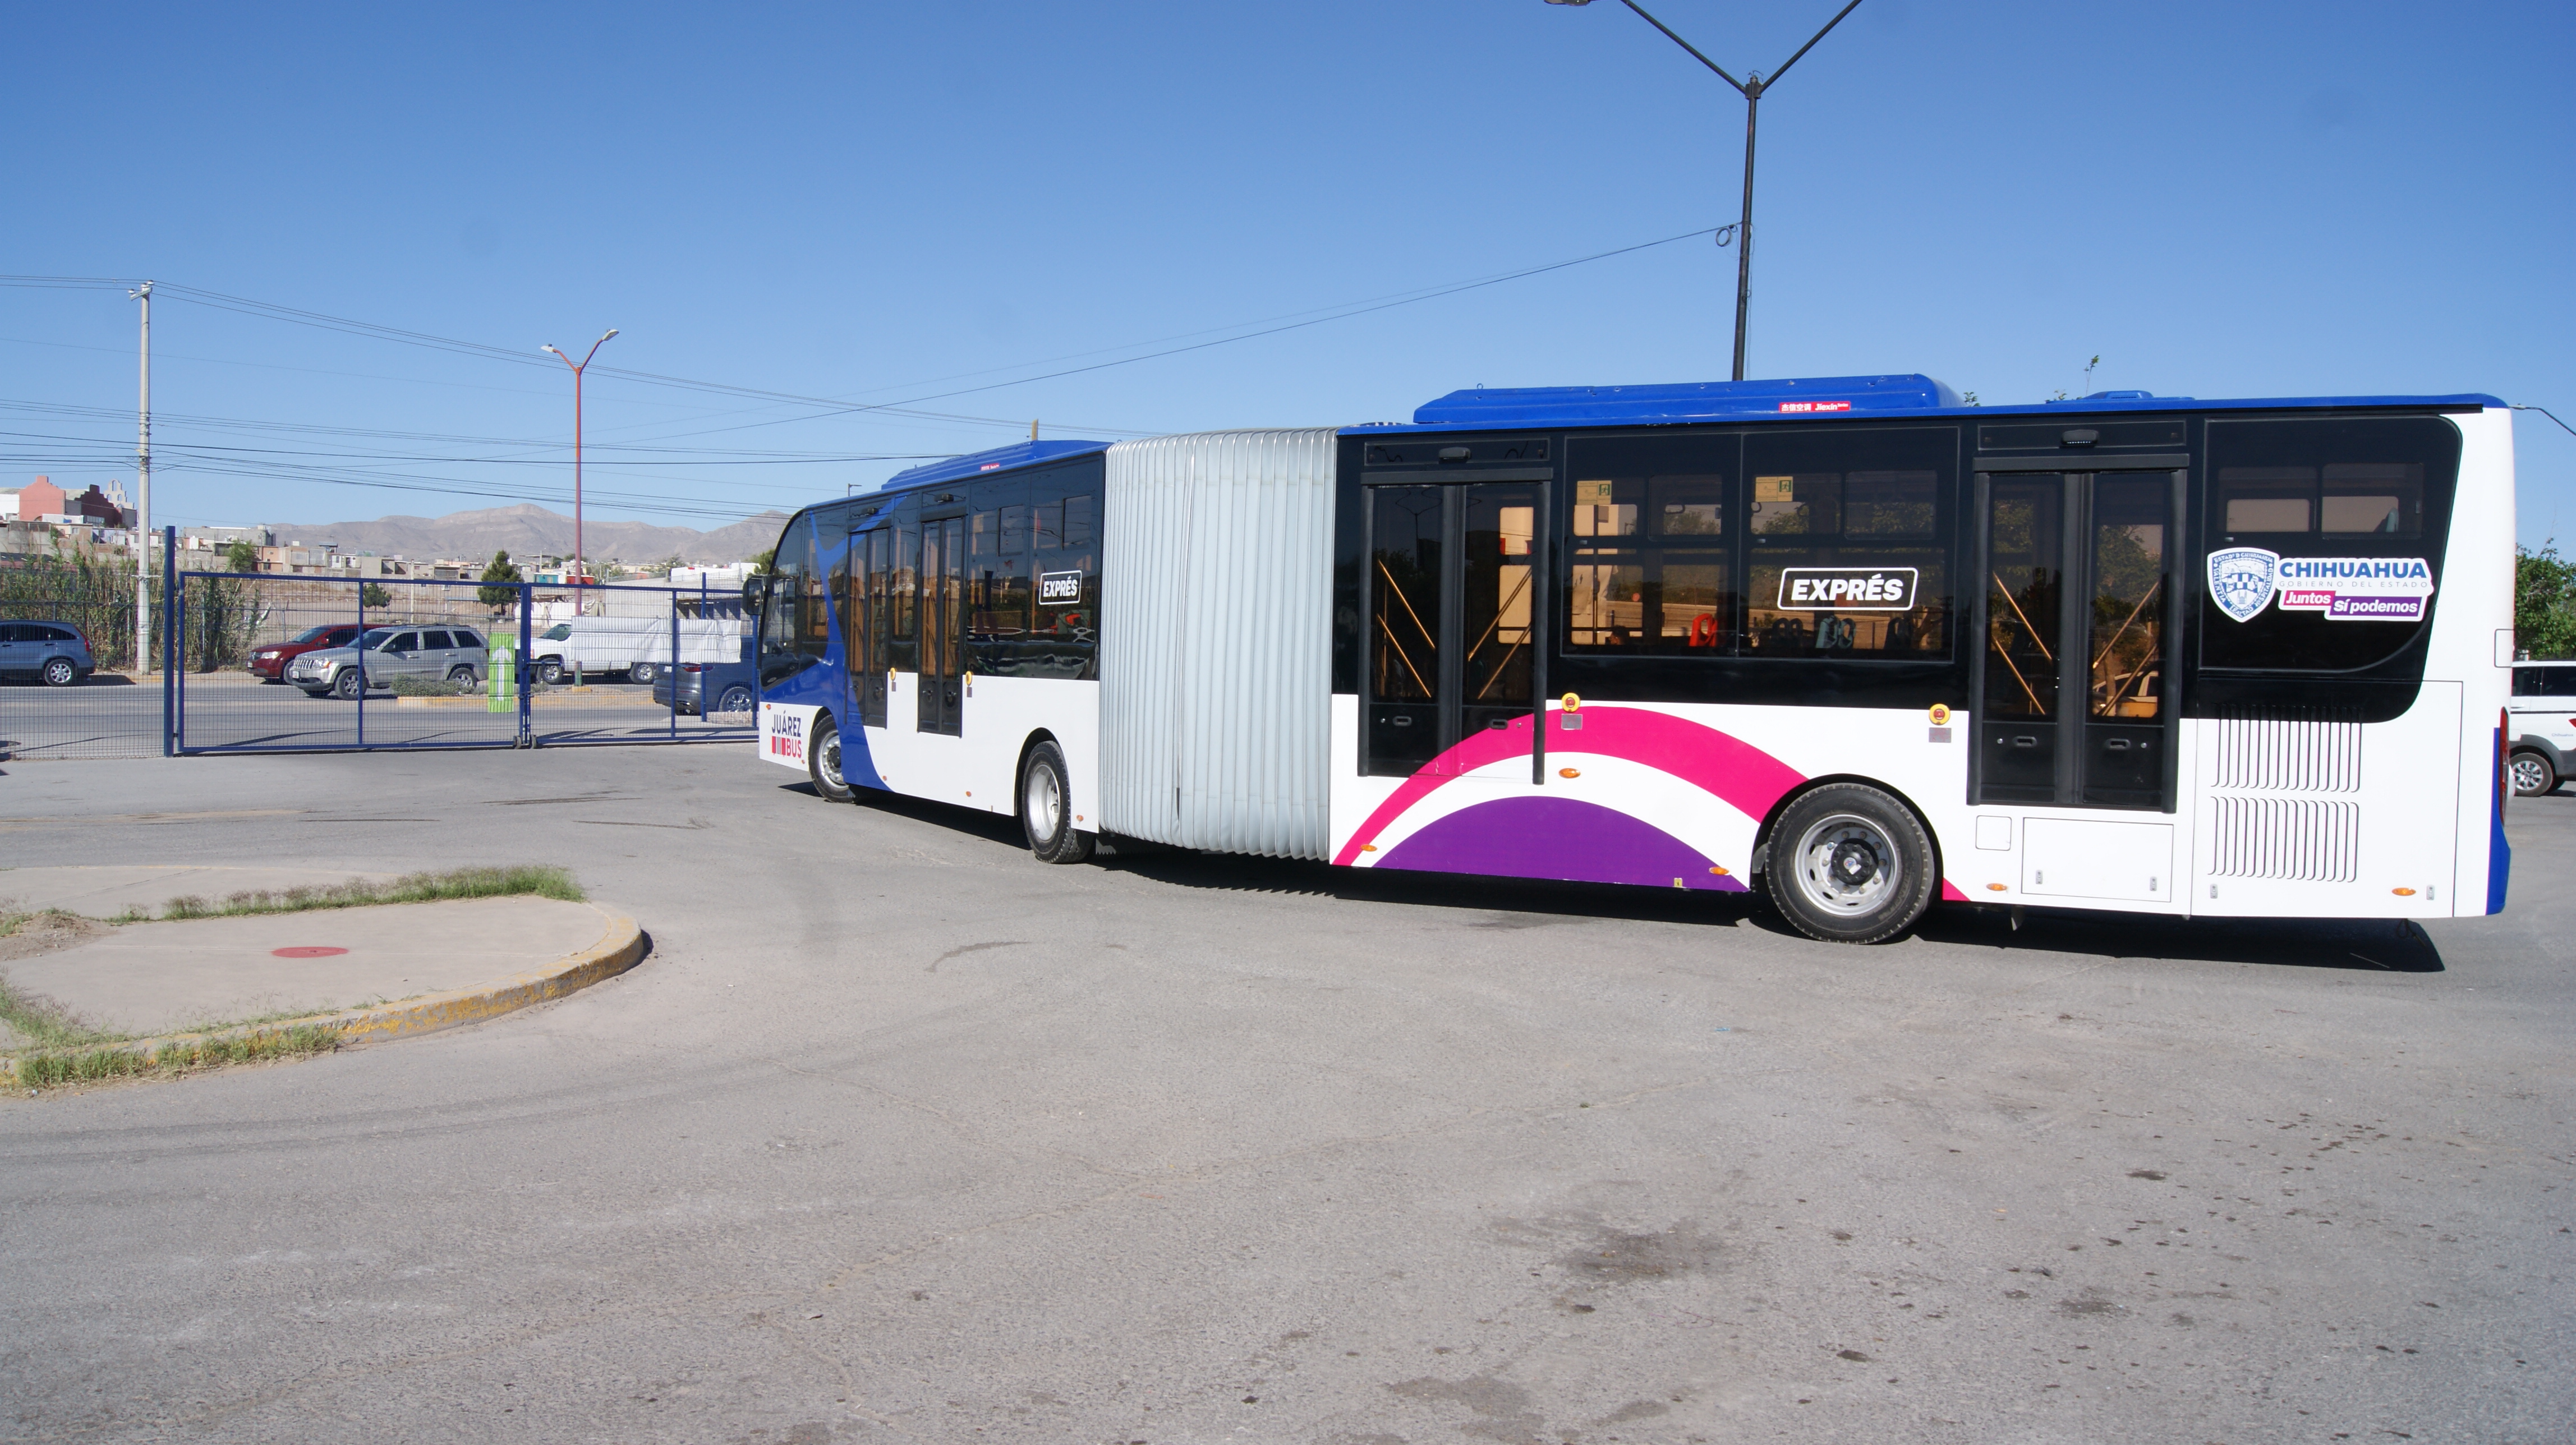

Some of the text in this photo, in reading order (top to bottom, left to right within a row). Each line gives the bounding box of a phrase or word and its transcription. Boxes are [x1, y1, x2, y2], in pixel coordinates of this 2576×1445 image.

[2279, 562, 2427, 578] CHIHUAHUA
[1043, 576, 1078, 597] EXPRÉS
[1791, 573, 1903, 601] EXPRÉS
[2286, 592, 2331, 604] Juntos
[2333, 599, 2418, 614] Sí podemos
[772, 710, 801, 738] JUÁREZ
[786, 738, 802, 759] BUS
